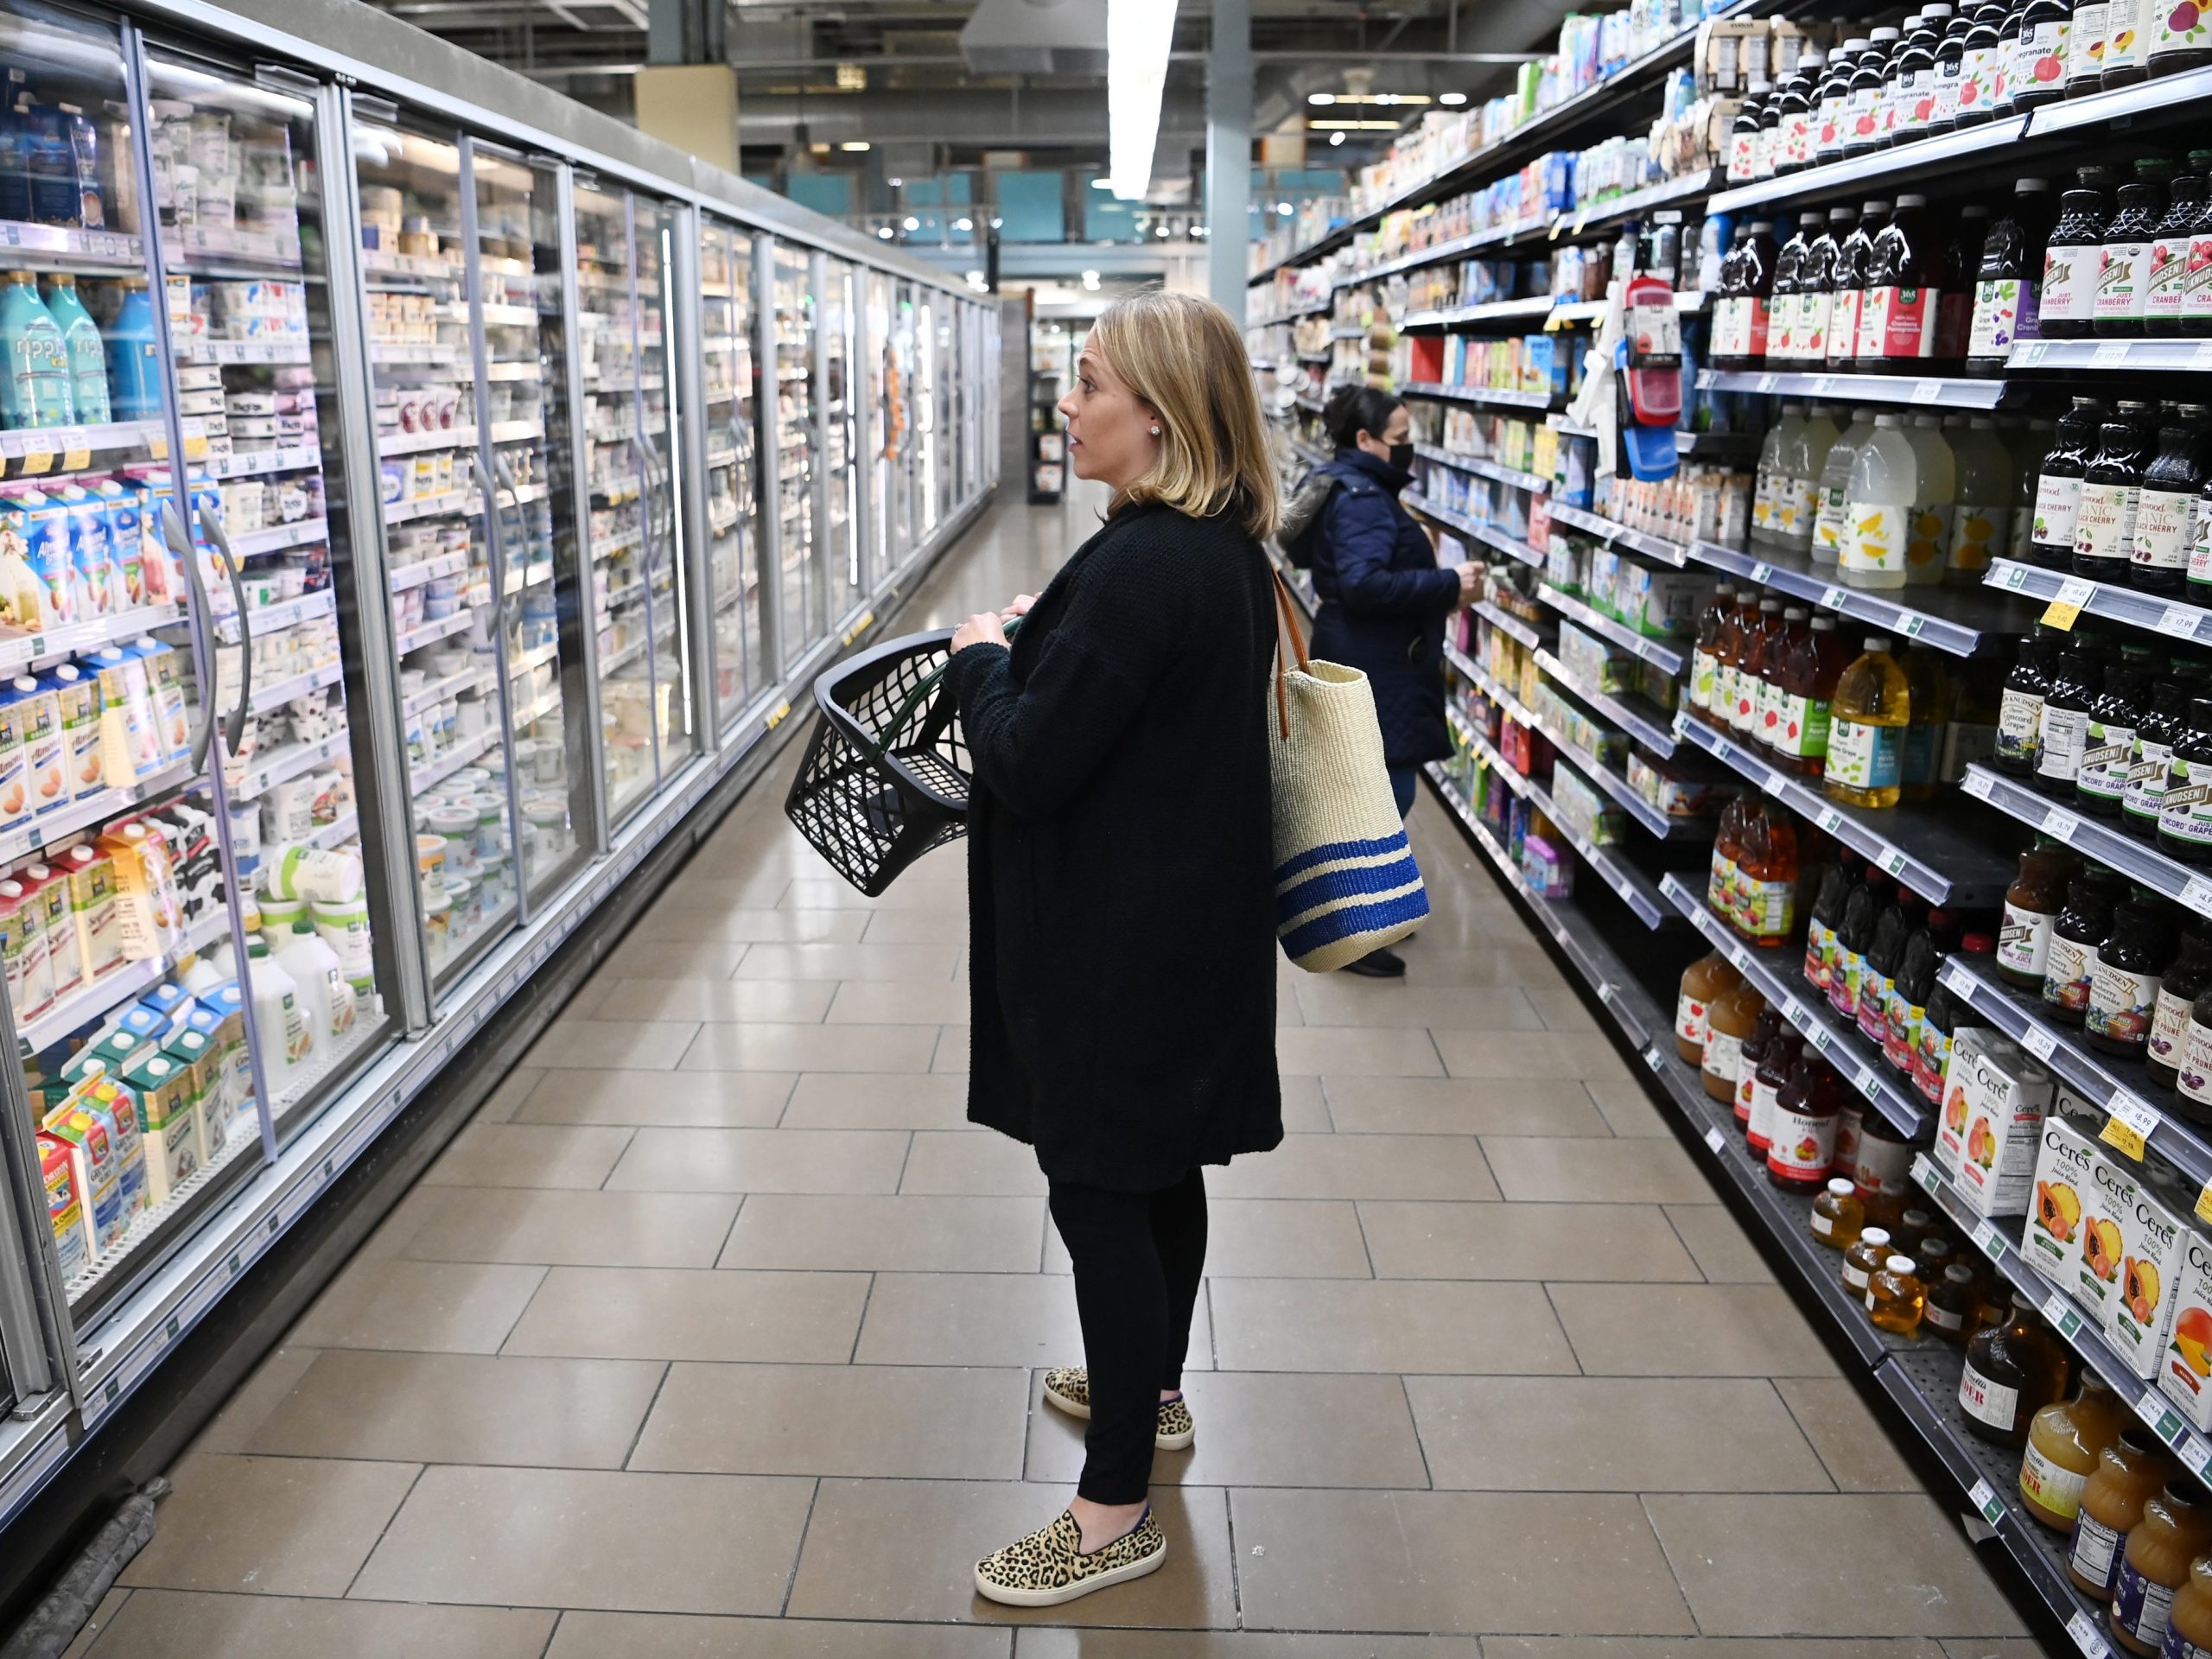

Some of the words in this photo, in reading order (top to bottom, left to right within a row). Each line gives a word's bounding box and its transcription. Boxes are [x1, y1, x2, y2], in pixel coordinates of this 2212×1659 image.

[2022, 29, 2033, 38] 365
[1946, 62, 1959, 72] 365
[2047, 503, 2072, 512] CHERRY
[2089, 516, 2116, 525] CHERRY
[2149, 524, 2177, 534] CHERRY
[2010, 696, 2040, 711] KNUDSEN
[2003, 711, 2032, 724] Concord
[2004, 720, 2026, 732] Grape
[2083, 747, 2117, 764] KNUDSEN
[2106, 781, 2126, 791] GRAP
[2166, 788, 2201, 804] KNUDSEN
[2140, 800, 2161, 810] GRAPE
[2098, 966, 2128, 988] KNUDSEN
[2160, 1023, 2181, 1038] PRUNE
[1954, 1039, 1978, 1069] Cere
[2192, 1057, 2212, 1071] PRUNE
[1977, 1067, 2007, 1103] Ceres
[2135, 1112, 2152, 1127] $8.99
[2045, 1131, 2091, 1172] Ceres
[43, 1160, 69, 1185] ORIZON
[2056, 1158, 2078, 1178] 100%
[2095, 1166, 2133, 1211] Ceres
[2104, 1193, 2123, 1215] 100%
[2136, 1203, 2174, 1250] Ceres
[2143, 1233, 2163, 1256] 100%
[2198, 1278, 2212, 1295] 100
[2178, 1367, 2193, 1385] MANGO
